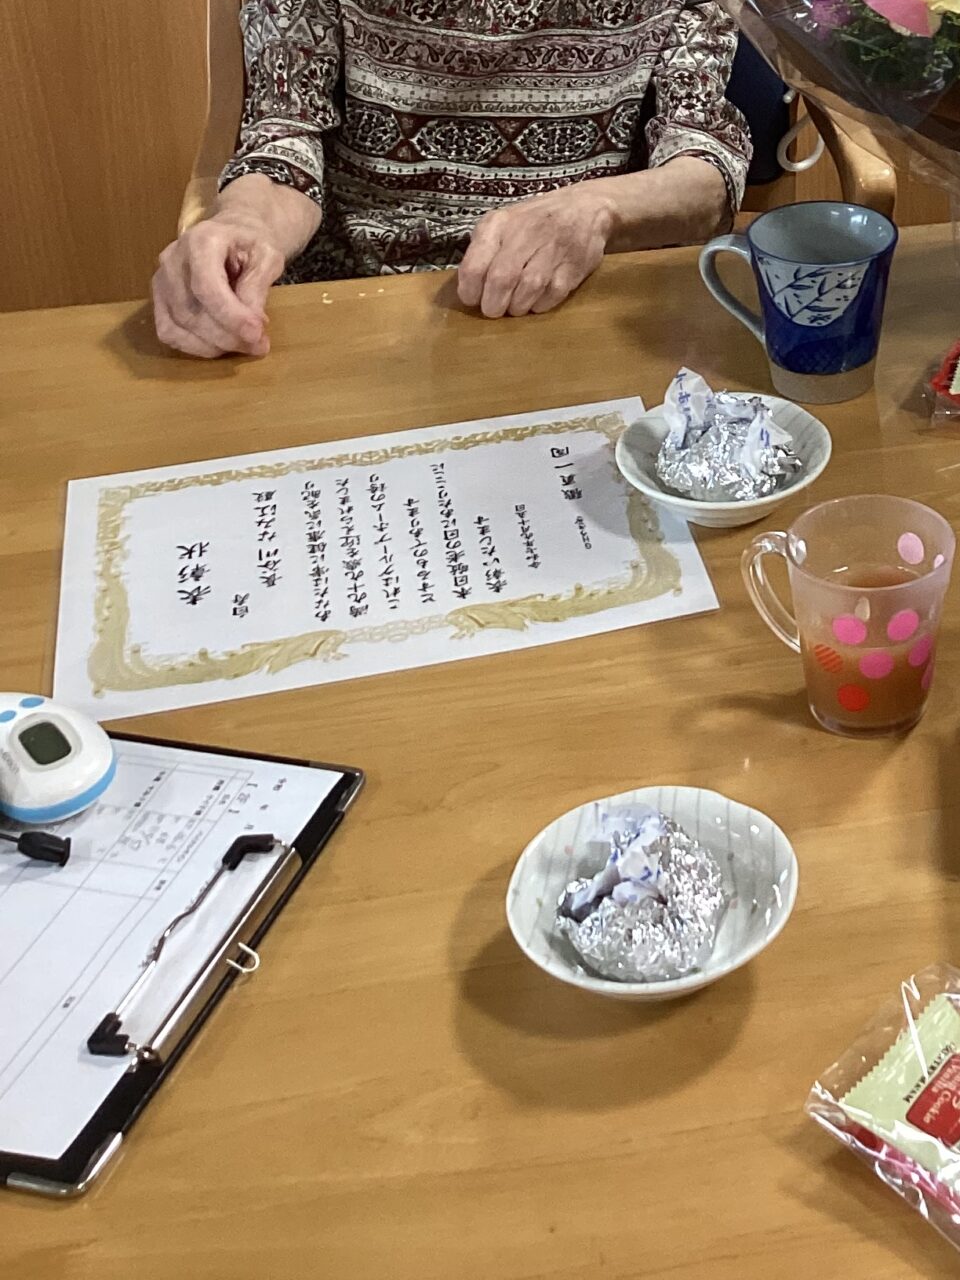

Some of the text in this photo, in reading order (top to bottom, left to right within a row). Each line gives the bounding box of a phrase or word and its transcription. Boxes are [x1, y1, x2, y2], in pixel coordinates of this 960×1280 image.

[550, 445, 584, 501] 職員一同
[256, 548, 284, 588] 長谷川
[300, 480, 333, 622] あなたは常に健康に気を配り
[335, 477, 369, 619] 満九十九歳を迎えられました
[367, 472, 401, 611] これはグループホームの誇り
[402, 497, 437, 605] とするものであります
[429, 462, 473, 600] 本日敬老の日にあたりここに
[473, 514, 508, 594] 表彰いたします
[175, 541, 212, 606] 表彰状
[231, 593, 251, 619] 白寿
[922, 1090, 952, 1125] Cookie
